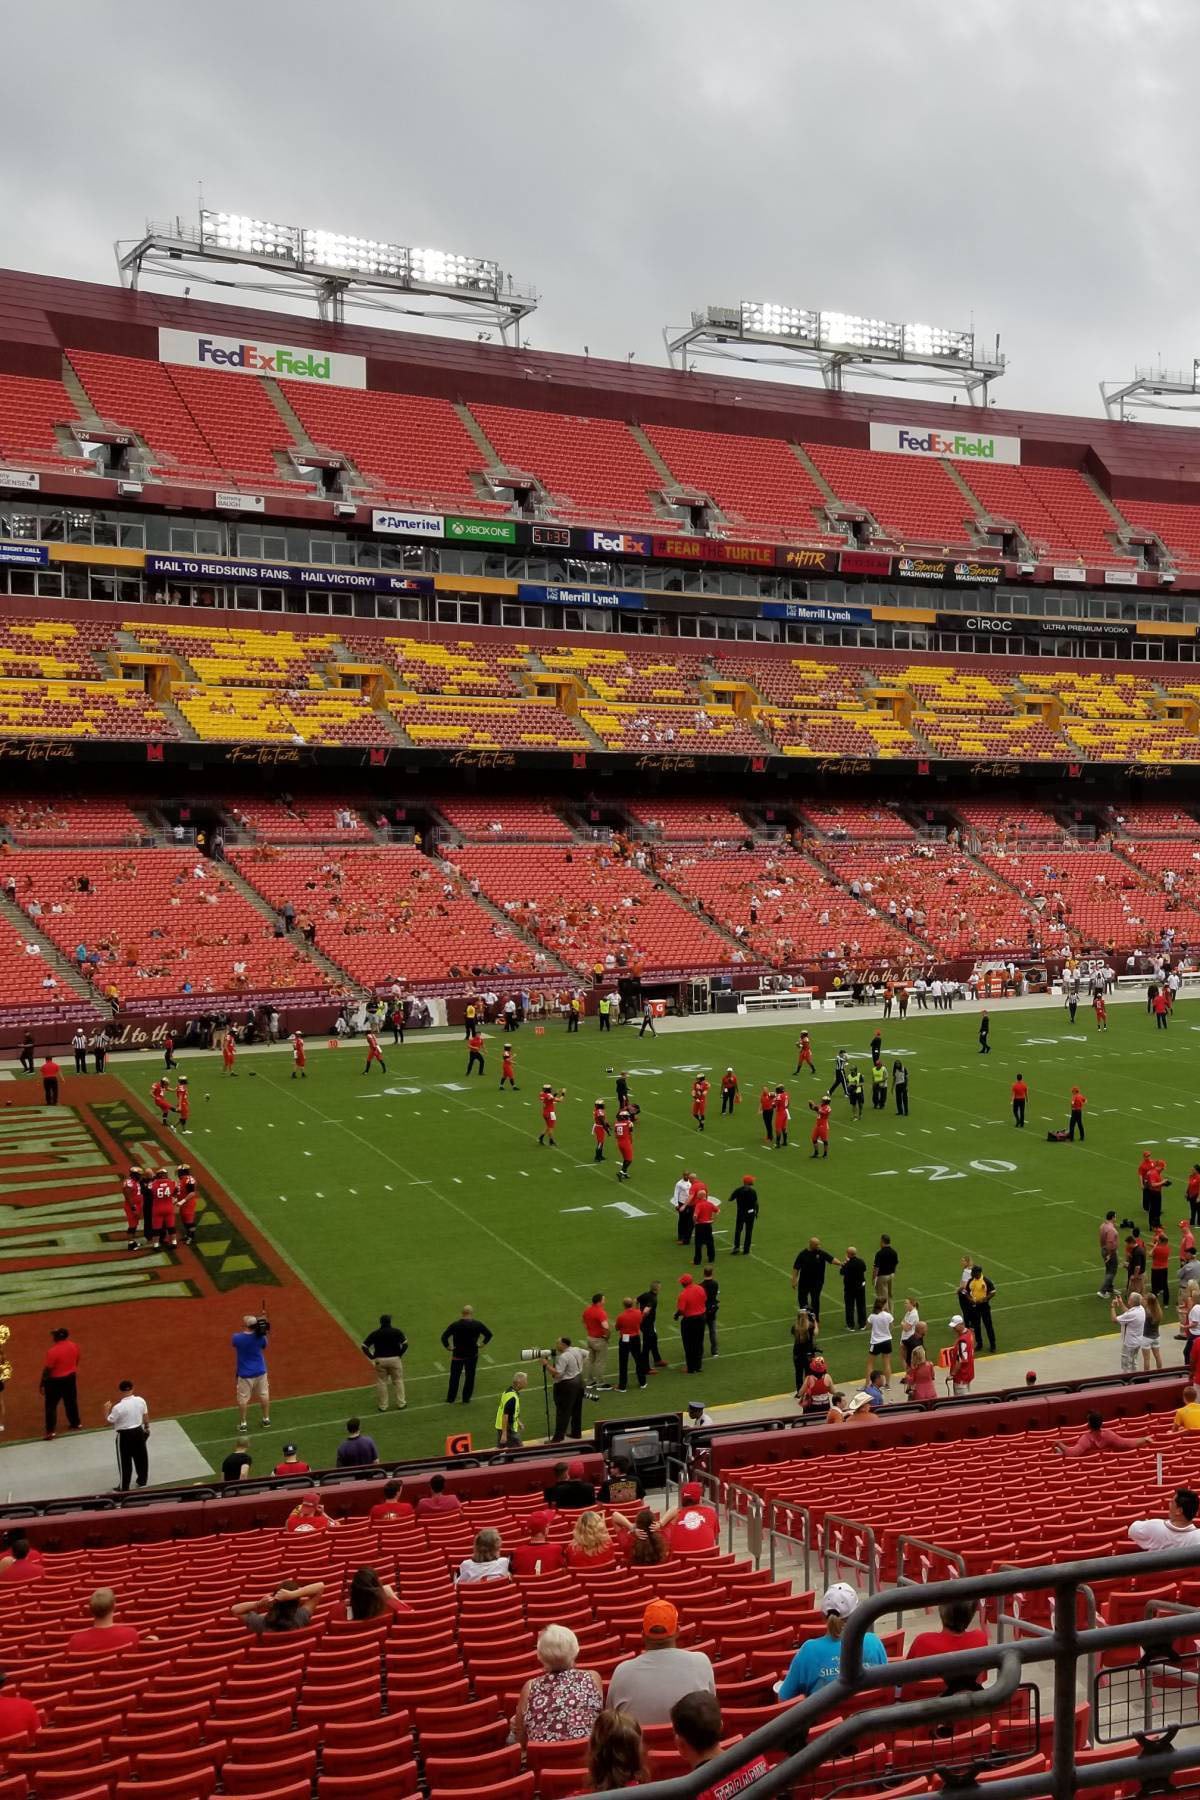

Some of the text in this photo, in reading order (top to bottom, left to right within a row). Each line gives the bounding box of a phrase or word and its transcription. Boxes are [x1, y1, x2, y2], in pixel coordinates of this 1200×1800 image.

[198, 338, 330, 379] FedExField
[899, 430, 994, 458] FedExField
[387, 516, 441, 532] Ameritel
[465, 524, 510, 537] XBOX ONE
[593, 532, 644, 554] FedEx
[154, 560, 292, 581] HAIL TO REDSKINS FANS.
[913, 560, 947, 574] Sports
[969, 563, 1002, 577] Sports
[301, 571, 376, 587] HAIL VICTORY!
[900, 570, 944, 580] WASHINGTON
[955, 574, 999, 583] WASHINGTON
[390, 578, 421, 590] FedEx
[559, 590, 591, 603] Merrill
[592, 592, 619, 606] Lynch
[798, 608, 826, 619] Merrill
[827, 610, 851, 622] Lynch
[1043, 623, 1129, 635] ULTRA PREMIUM VODKA
[868, 972, 879, 984] to
[880, 970, 899, 983] the
[655, 1003, 665, 1013] G
[131, 1027, 149, 1043] to
[907, 1159, 1018, 1181] 20
[156, 1186, 171, 1198] 64
[451, 1436, 471, 1455] G
